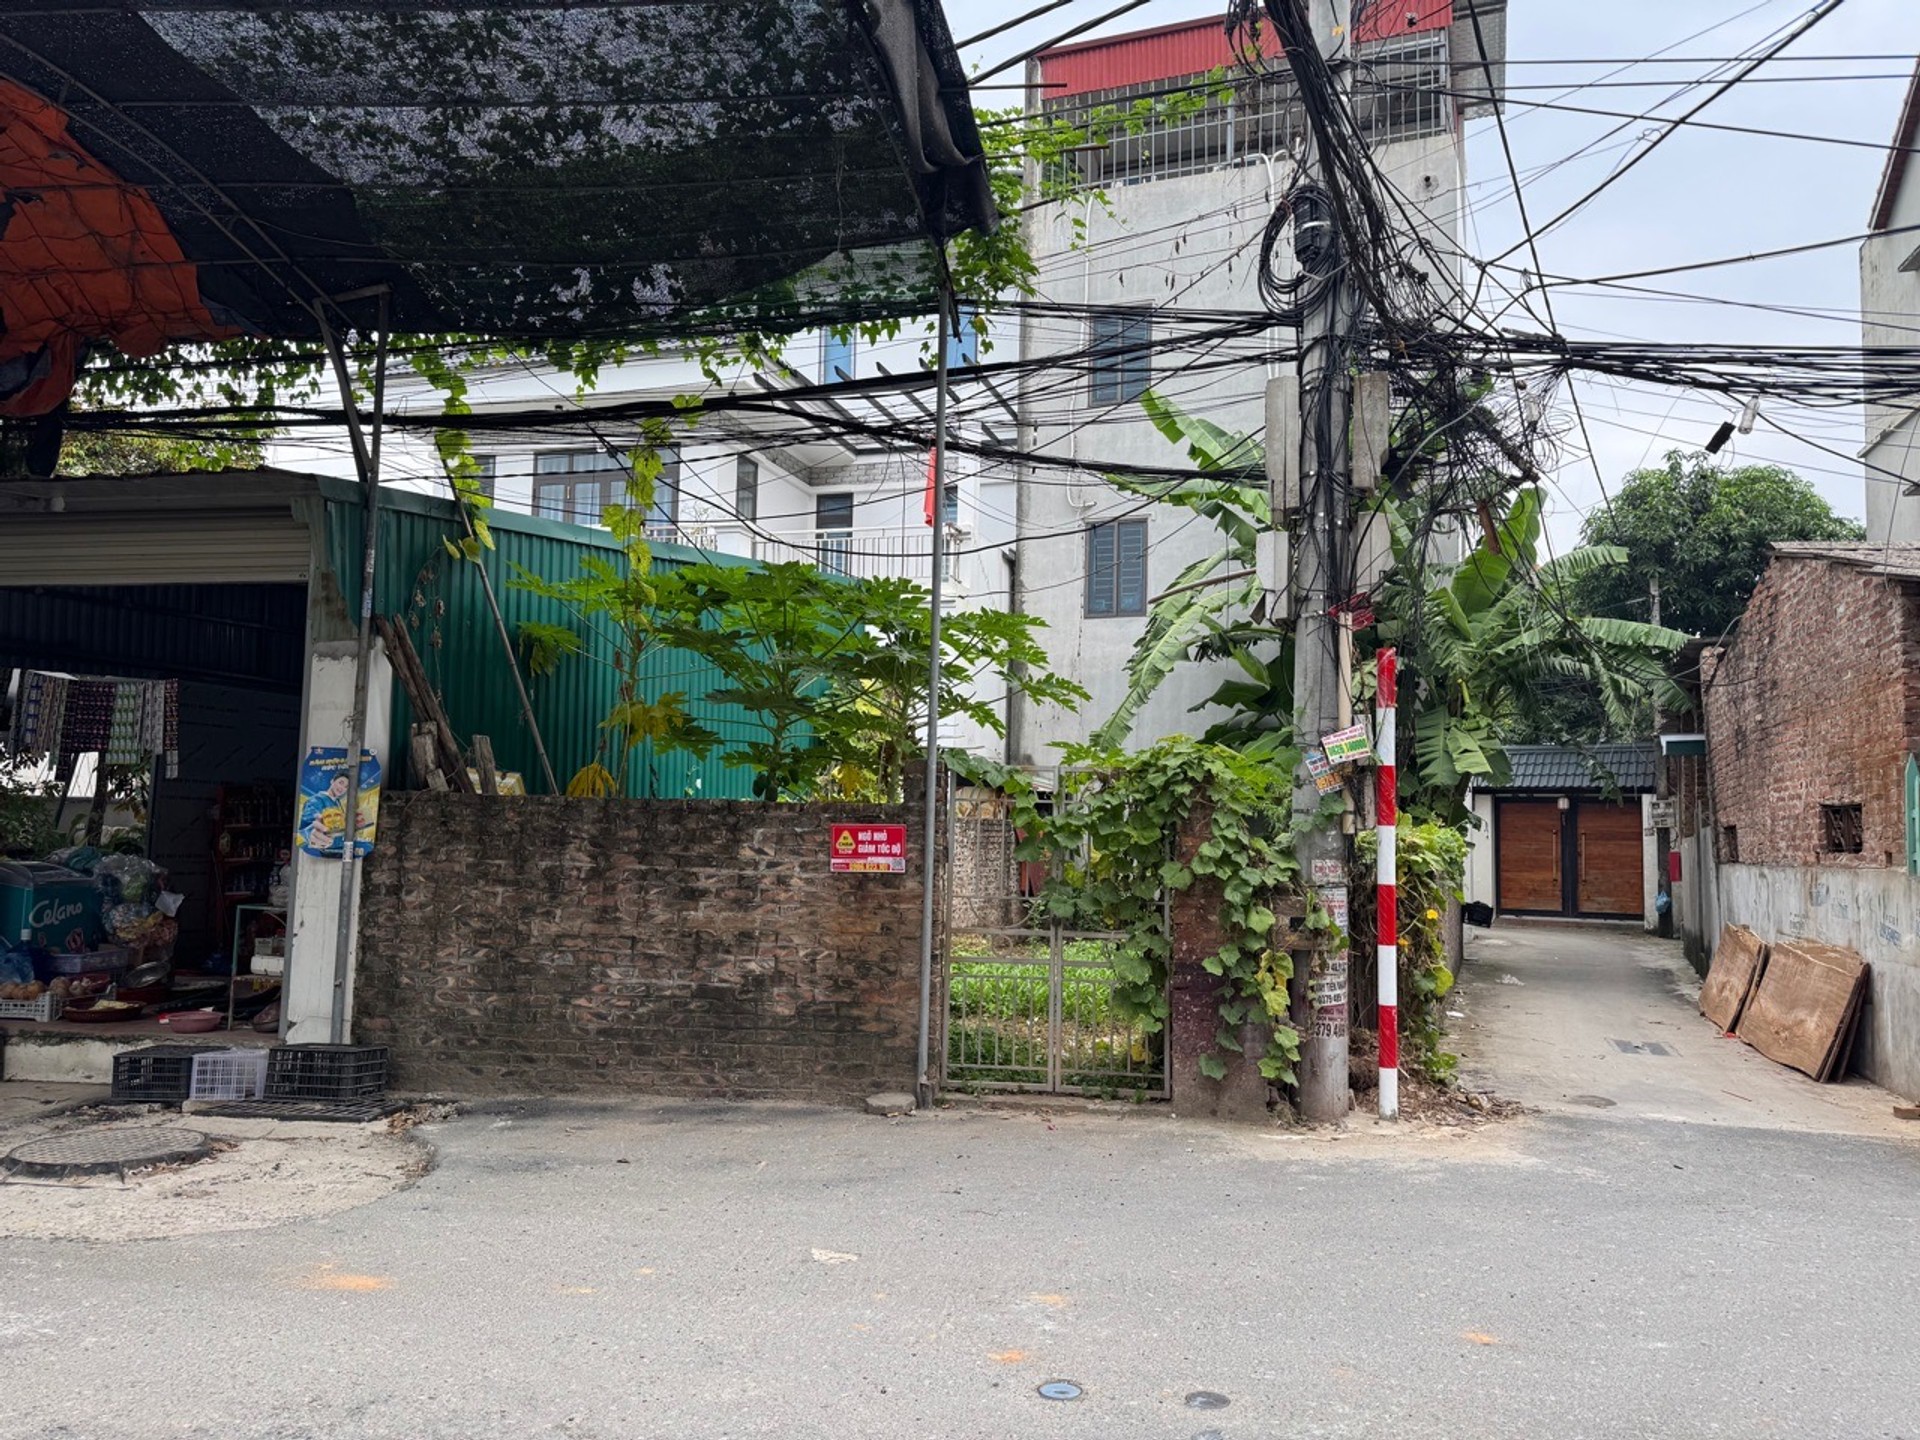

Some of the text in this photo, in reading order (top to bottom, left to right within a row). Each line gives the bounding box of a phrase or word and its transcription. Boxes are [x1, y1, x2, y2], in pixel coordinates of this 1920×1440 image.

[858, 829, 888, 841] NGÕ NHỎ
[858, 842, 876, 853] GIẢM
[877, 842, 890, 854] TỐC
[29, 898, 83, 928] Celano
